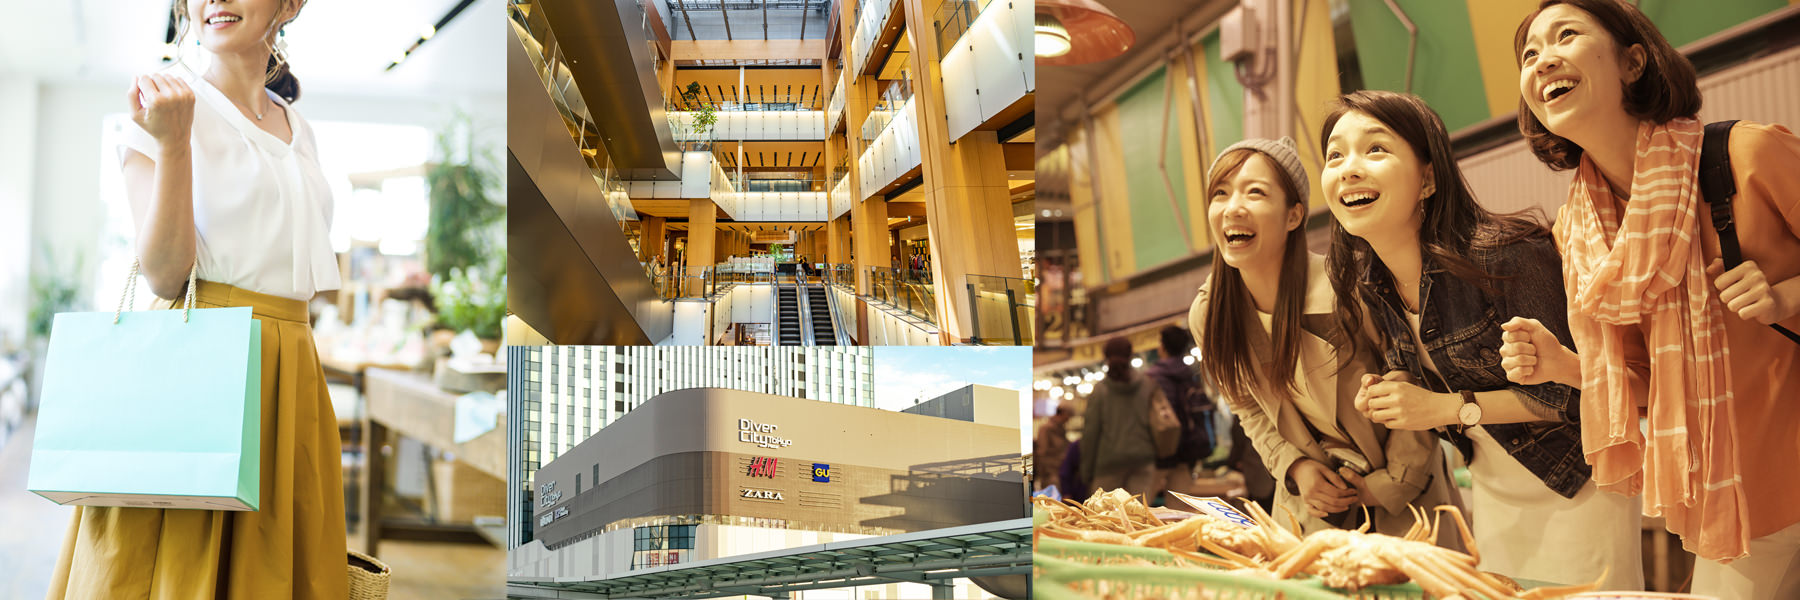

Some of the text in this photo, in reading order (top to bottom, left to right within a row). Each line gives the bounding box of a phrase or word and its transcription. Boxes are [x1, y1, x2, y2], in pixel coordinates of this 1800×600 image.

[740, 418, 778, 433] Diver
[814, 468, 830, 478] GU
[744, 488, 784, 500] ZARA
